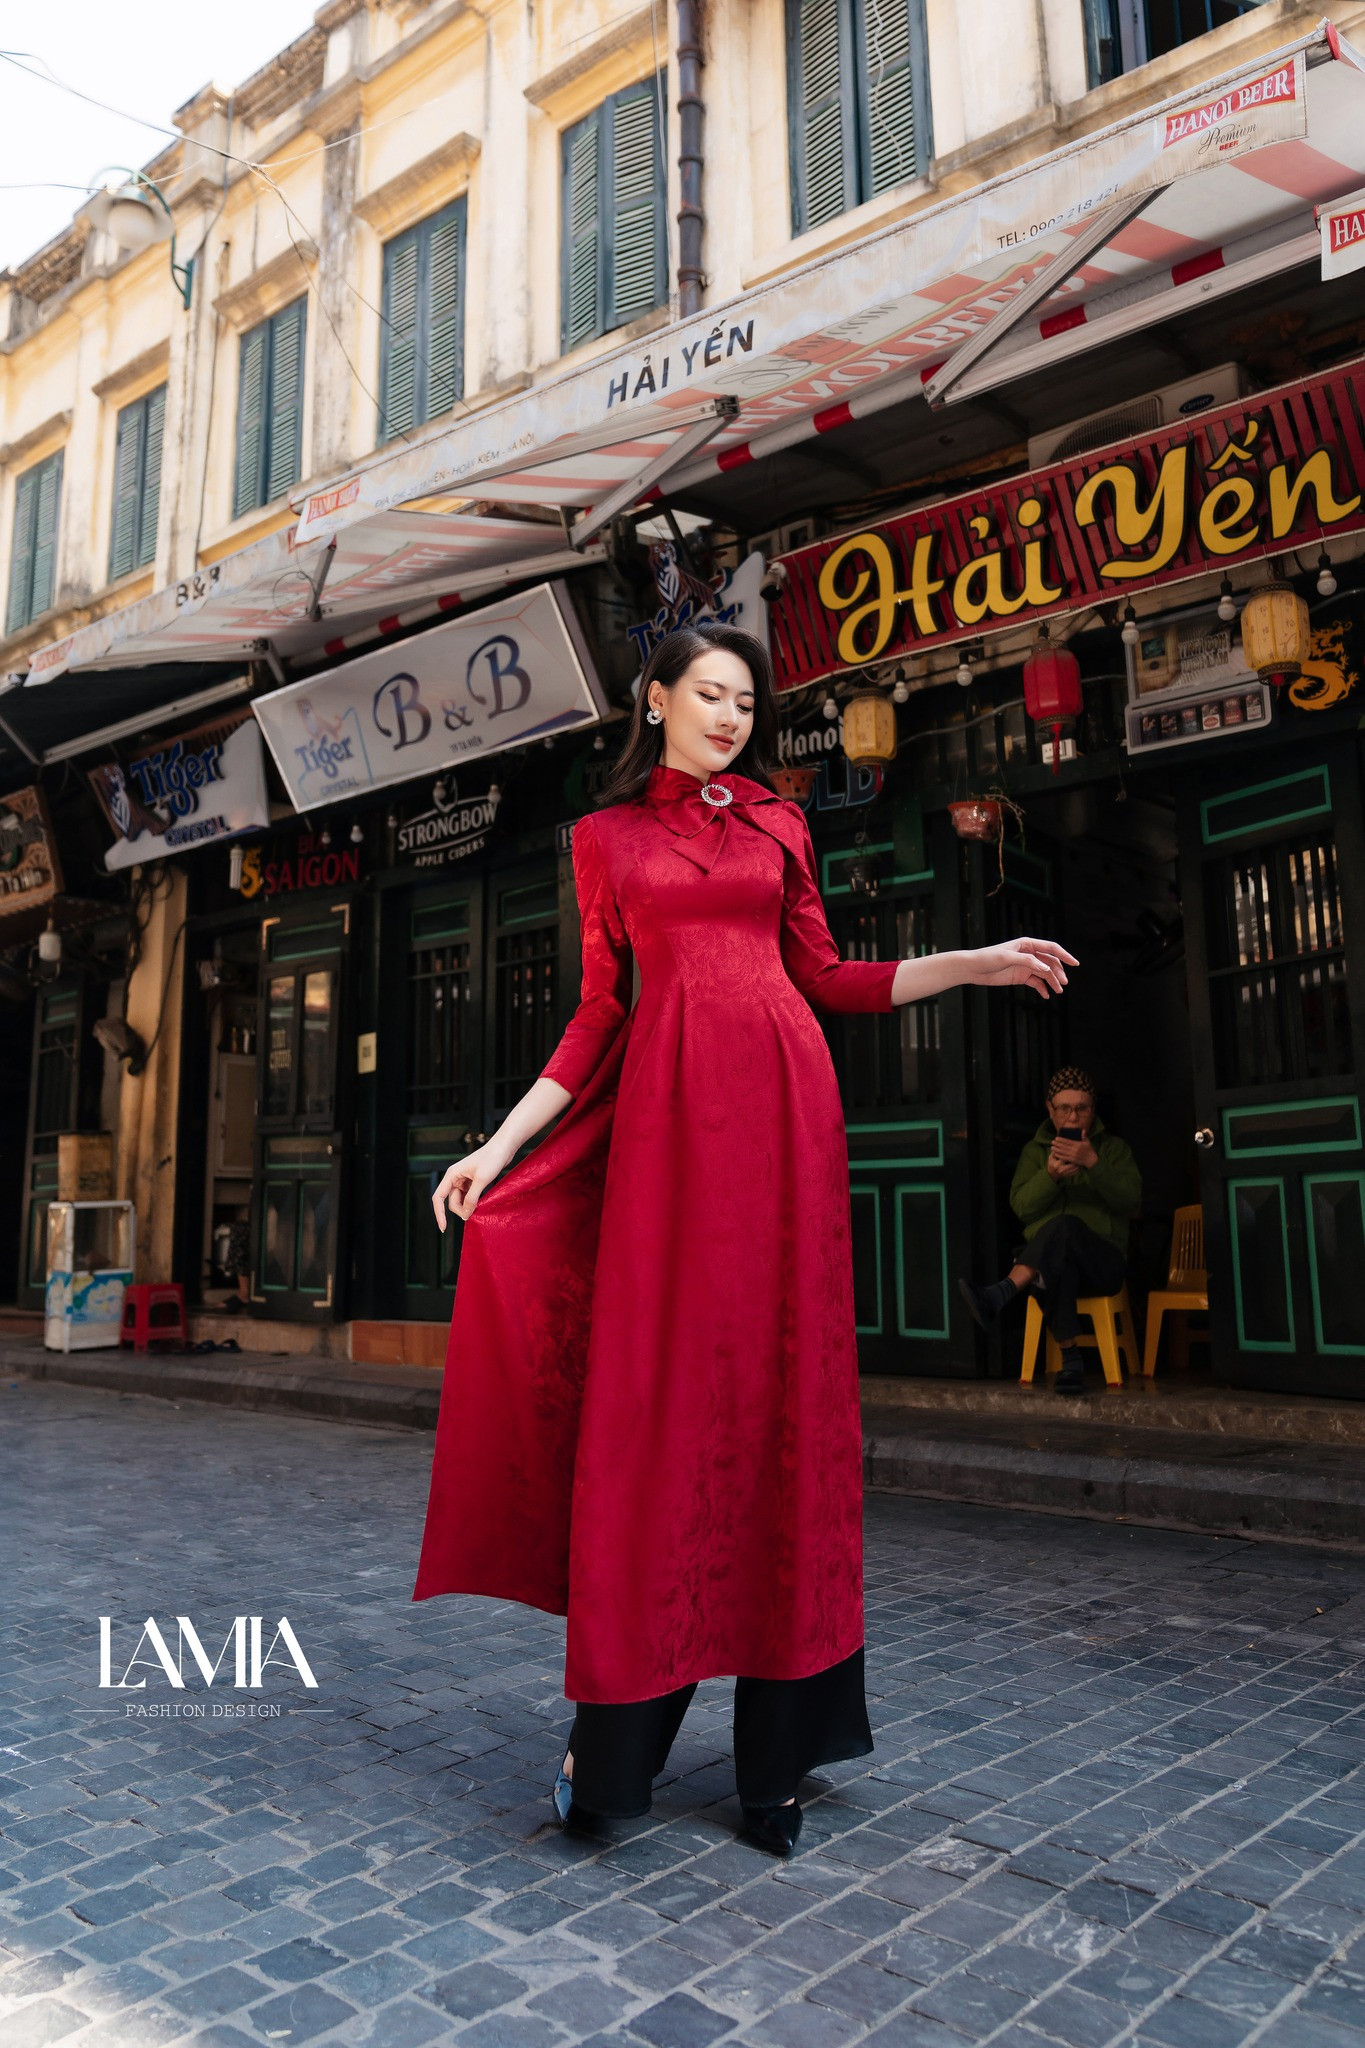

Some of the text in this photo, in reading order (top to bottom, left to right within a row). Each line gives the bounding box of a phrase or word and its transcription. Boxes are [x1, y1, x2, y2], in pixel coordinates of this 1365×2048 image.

[1167, 69, 1291, 143] HANOI BEER
[1198, 122, 1258, 155] Premium
[1219, 140, 1239, 152] BEER
[997, 230, 1026, 249] TEL:
[607, 318, 755, 409] HẢI YẾN
[818, 420, 1363, 665] Hải Yến
[373, 634, 532, 750] B & B
[295, 734, 355, 779] Tiger
[777, 714, 845, 761] Hanoi
[129, 740, 220, 817] Tiger
[398, 801, 500, 851] STRONGBOW
[263, 847, 360, 895] SAIGON
[414, 837, 485, 868] APPLE CIDERS
